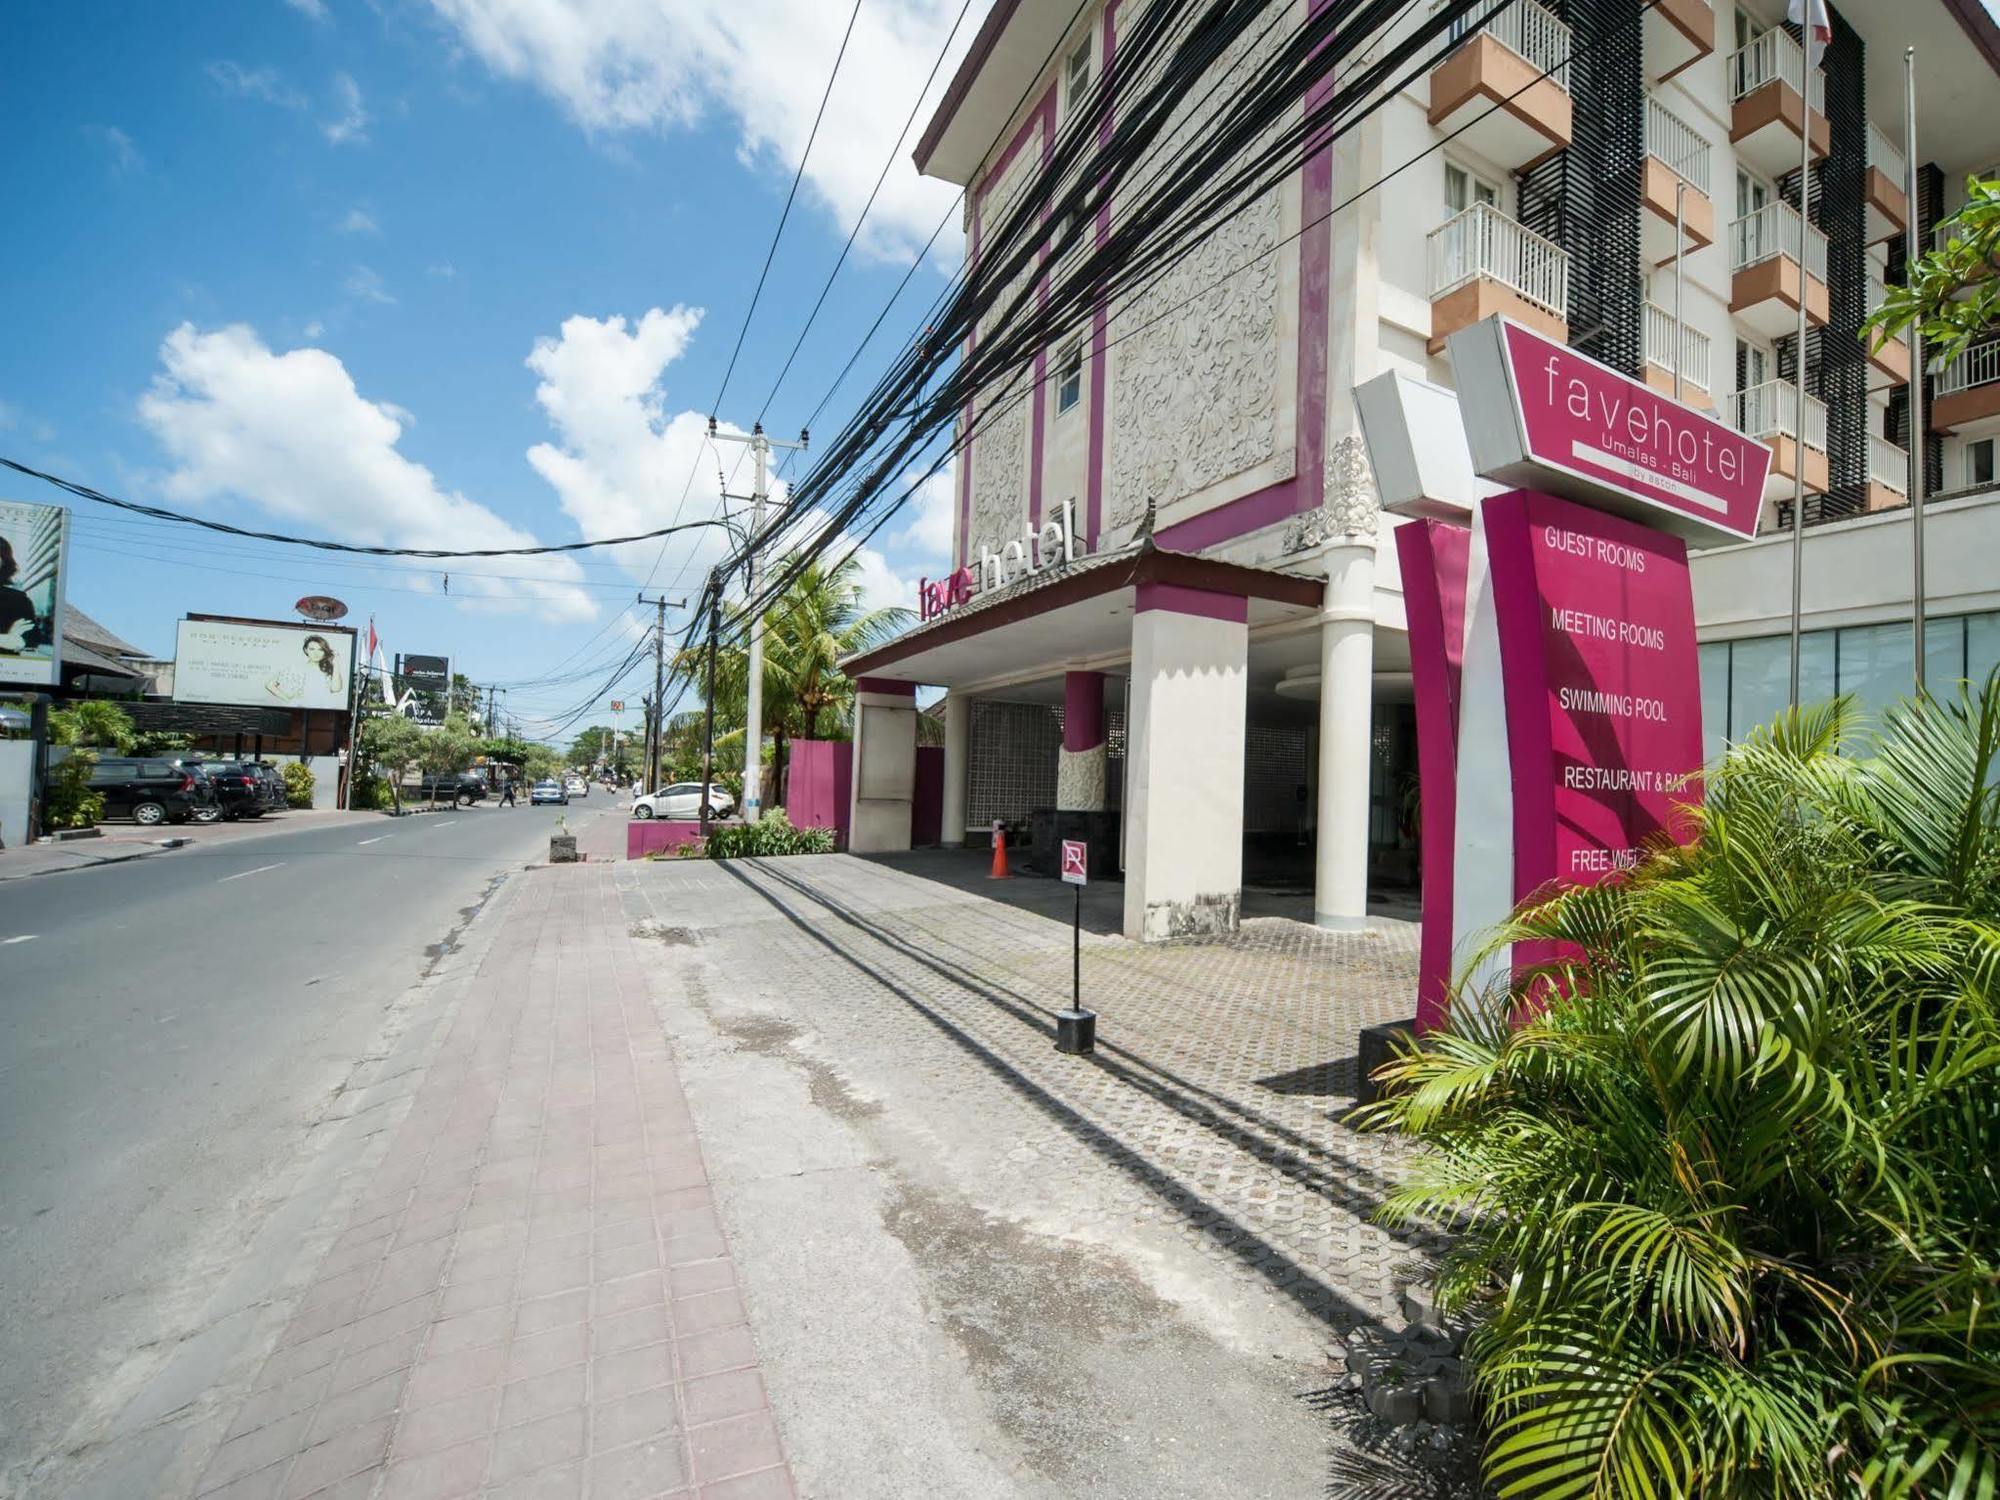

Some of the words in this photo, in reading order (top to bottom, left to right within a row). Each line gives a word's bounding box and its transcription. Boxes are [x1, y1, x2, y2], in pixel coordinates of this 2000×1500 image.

[1544, 356, 1745, 487] favehotel
[1601, 432, 1657, 468] Umalas
[1672, 461, 1697, 484] Bali
[1633, 465, 1646, 481] by
[1649, 471, 1679, 492] aston
[1545, 526, 1594, 559] GUEST
[1597, 540, 1645, 573] ROOMS
[1552, 607, 1616, 640] MEETING
[1619, 622, 1664, 650] ROOMS
[1559, 687, 1633, 717] SWIMMING
[1635, 697, 1667, 722] POOL
[1564, 766, 1653, 793] RESTAURANT
[1654, 771, 1663, 793] &
[1665, 772, 1688, 794] BAR
[1571, 849, 1608, 872] FREE
[1611, 847, 1638, 870] WiFi
